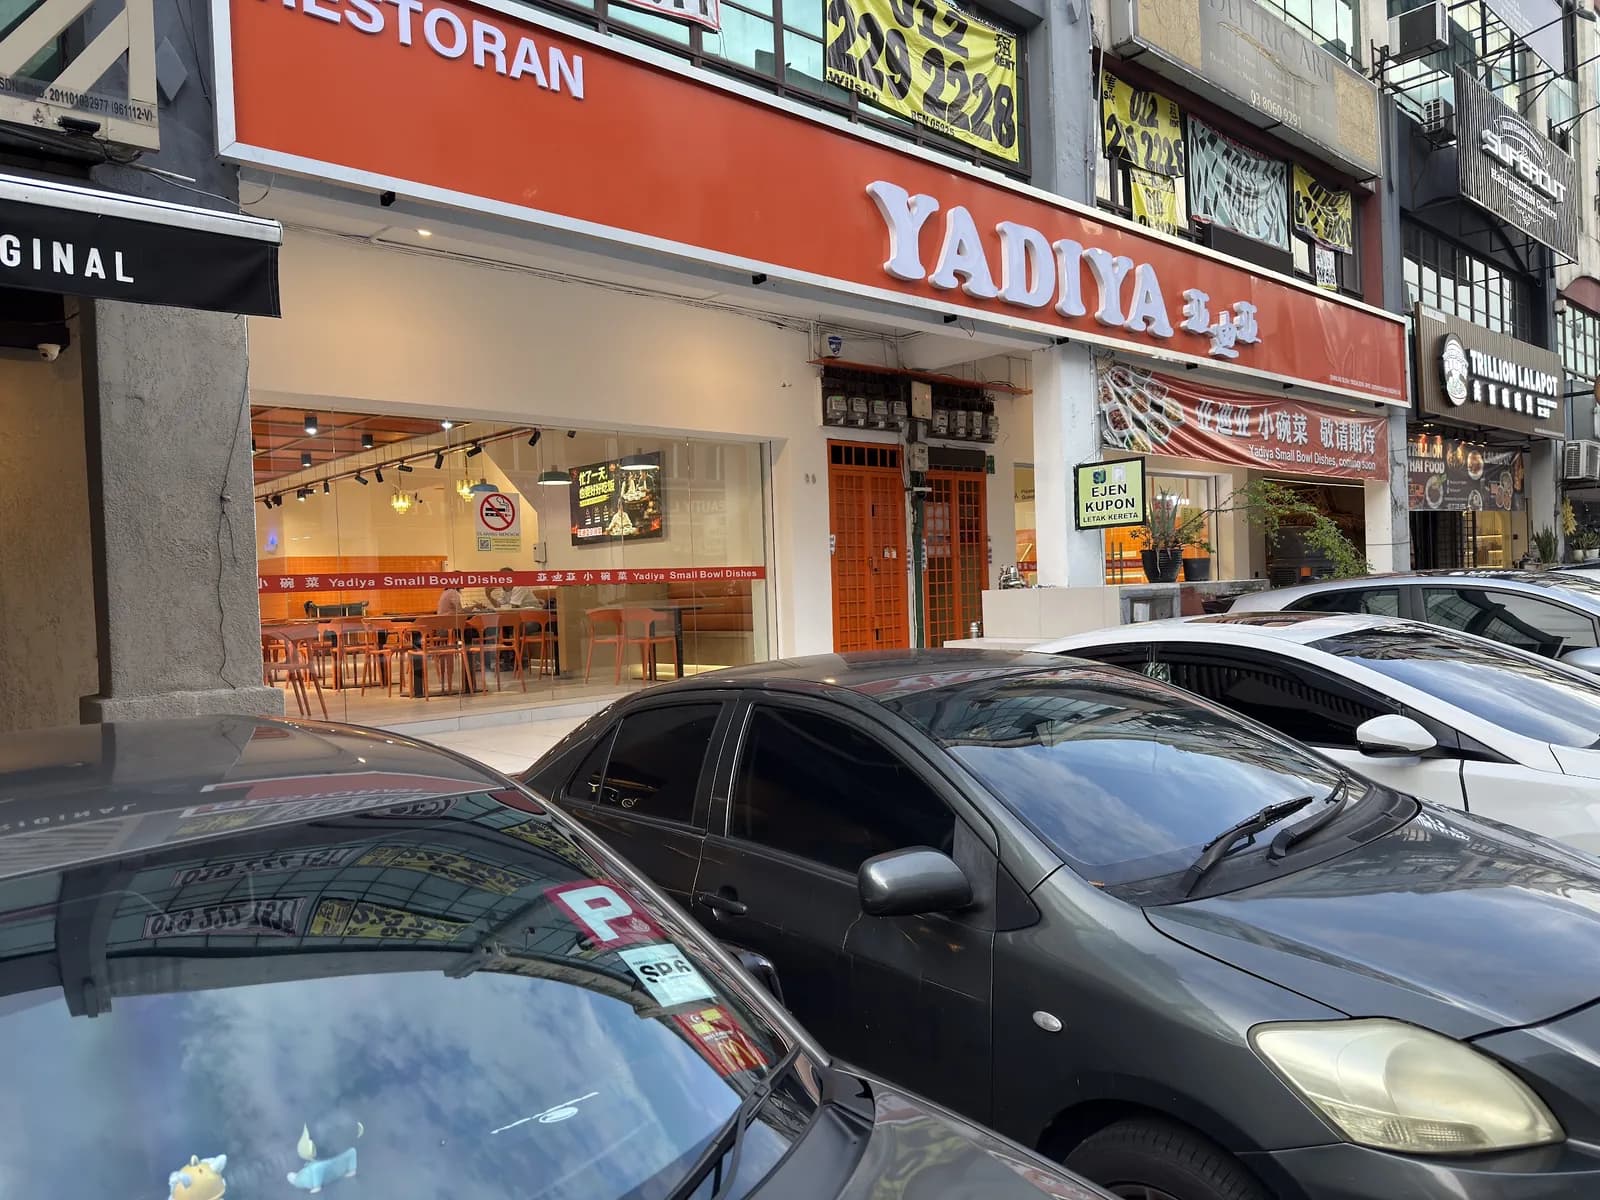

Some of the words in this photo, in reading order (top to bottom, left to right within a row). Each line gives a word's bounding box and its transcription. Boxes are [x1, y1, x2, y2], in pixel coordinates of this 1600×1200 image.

[827, 71, 880, 101] Wilson
[921, 48, 1016, 148] 2228
[1250, 88, 1261, 107] 03
[1482, 129, 1566, 203] SUPERCUT
[865, 180, 1174, 338] YADIYA
[1470, 349, 1517, 386] TRILLION
[1517, 365, 1558, 397] LALAPOT
[1258, 407, 1308, 446] 小碗菜
[1320, 416, 1377, 455] 敬请期待
[1275, 447, 1296, 461] Small
[1296, 452, 1313, 464] Bowl
[1314, 453, 1338, 468] Dishes,
[1424, 461, 1445, 474] FOOD
[1091, 483, 1127, 498] EJEN
[1085, 497, 1135, 513] KUPON
[1083, 515, 1106, 523] LETAK
[1108, 512, 1138, 521] KERETA
[328, 577, 375, 589] Yadiya
[383, 576, 425, 586] Small
[429, 575, 464, 585] Bowl
[467, 574, 513, 585] Dishes
[633, 572, 665, 582] Yadiya
[669, 570, 698, 580] Small
[699, 569, 723, 579] Bowl
[725, 569, 757, 578] Dishes
[557, 885, 633, 942] P
